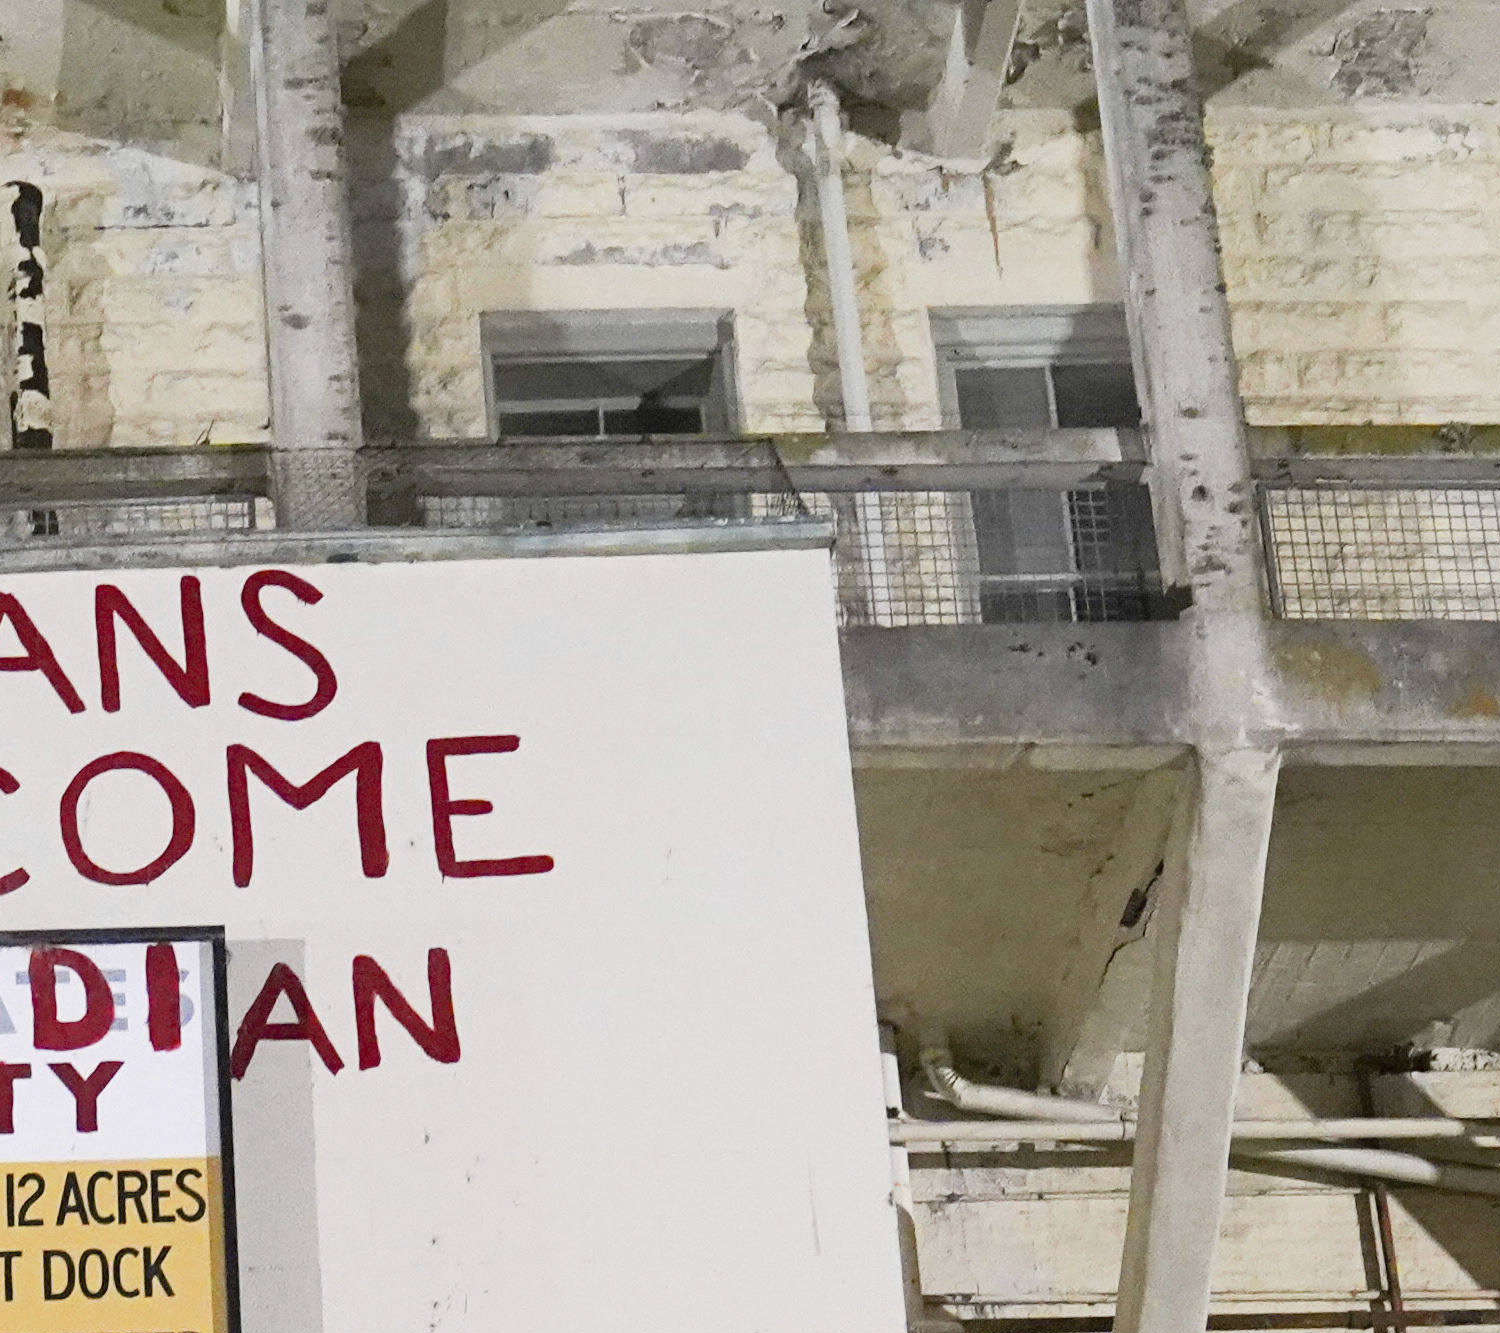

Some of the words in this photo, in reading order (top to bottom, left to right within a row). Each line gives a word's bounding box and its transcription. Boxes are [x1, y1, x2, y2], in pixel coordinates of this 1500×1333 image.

[5, 1172, 47, 1228] 12
[55, 1167, 207, 1227] ACRES
[41, 1245, 176, 1302] DOCK
